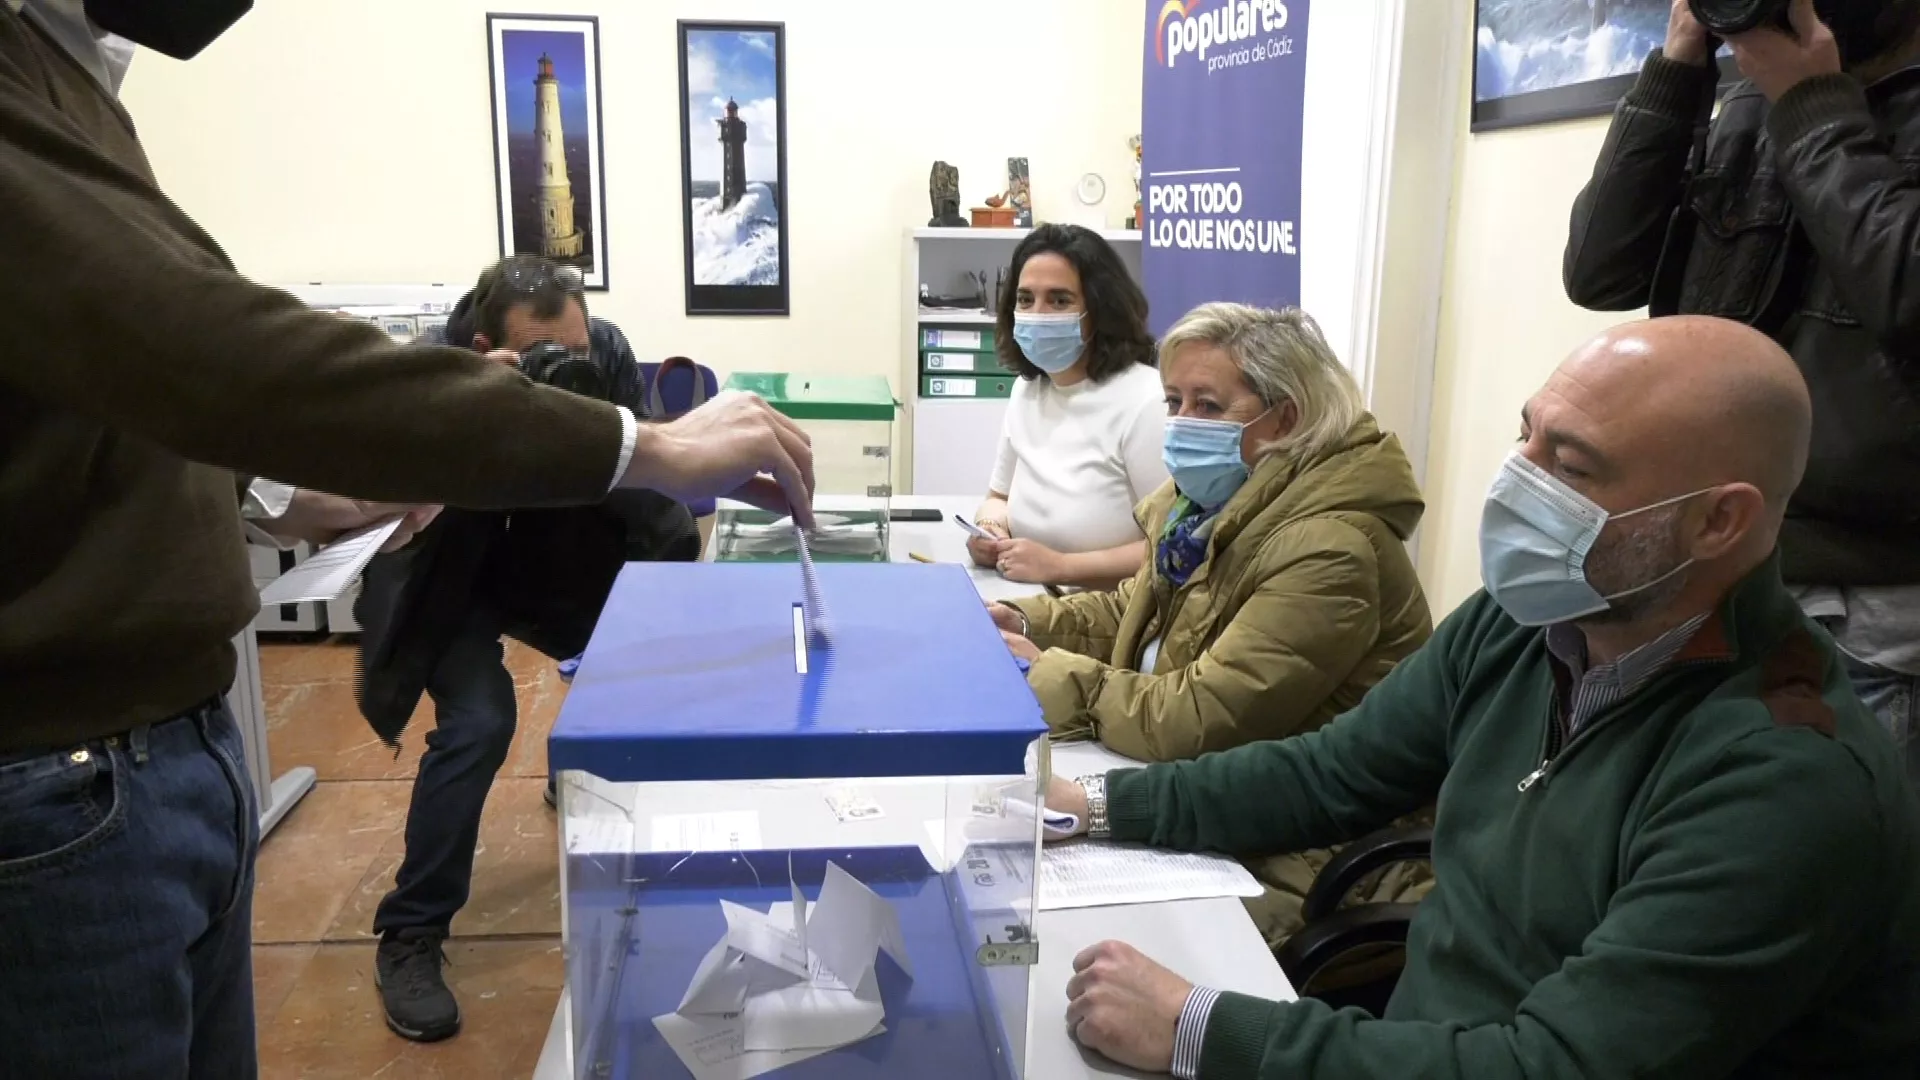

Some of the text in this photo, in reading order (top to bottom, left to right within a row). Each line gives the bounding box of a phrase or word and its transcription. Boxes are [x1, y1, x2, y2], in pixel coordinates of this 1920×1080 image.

[1167, 0, 1288, 68] populares
[1208, 44, 1249, 76] provincia
[1252, 42, 1266, 62] de
[1149, 182, 1242, 214] POR TODO
[1149, 218, 1297, 255] LO QUE NOS UNE.
